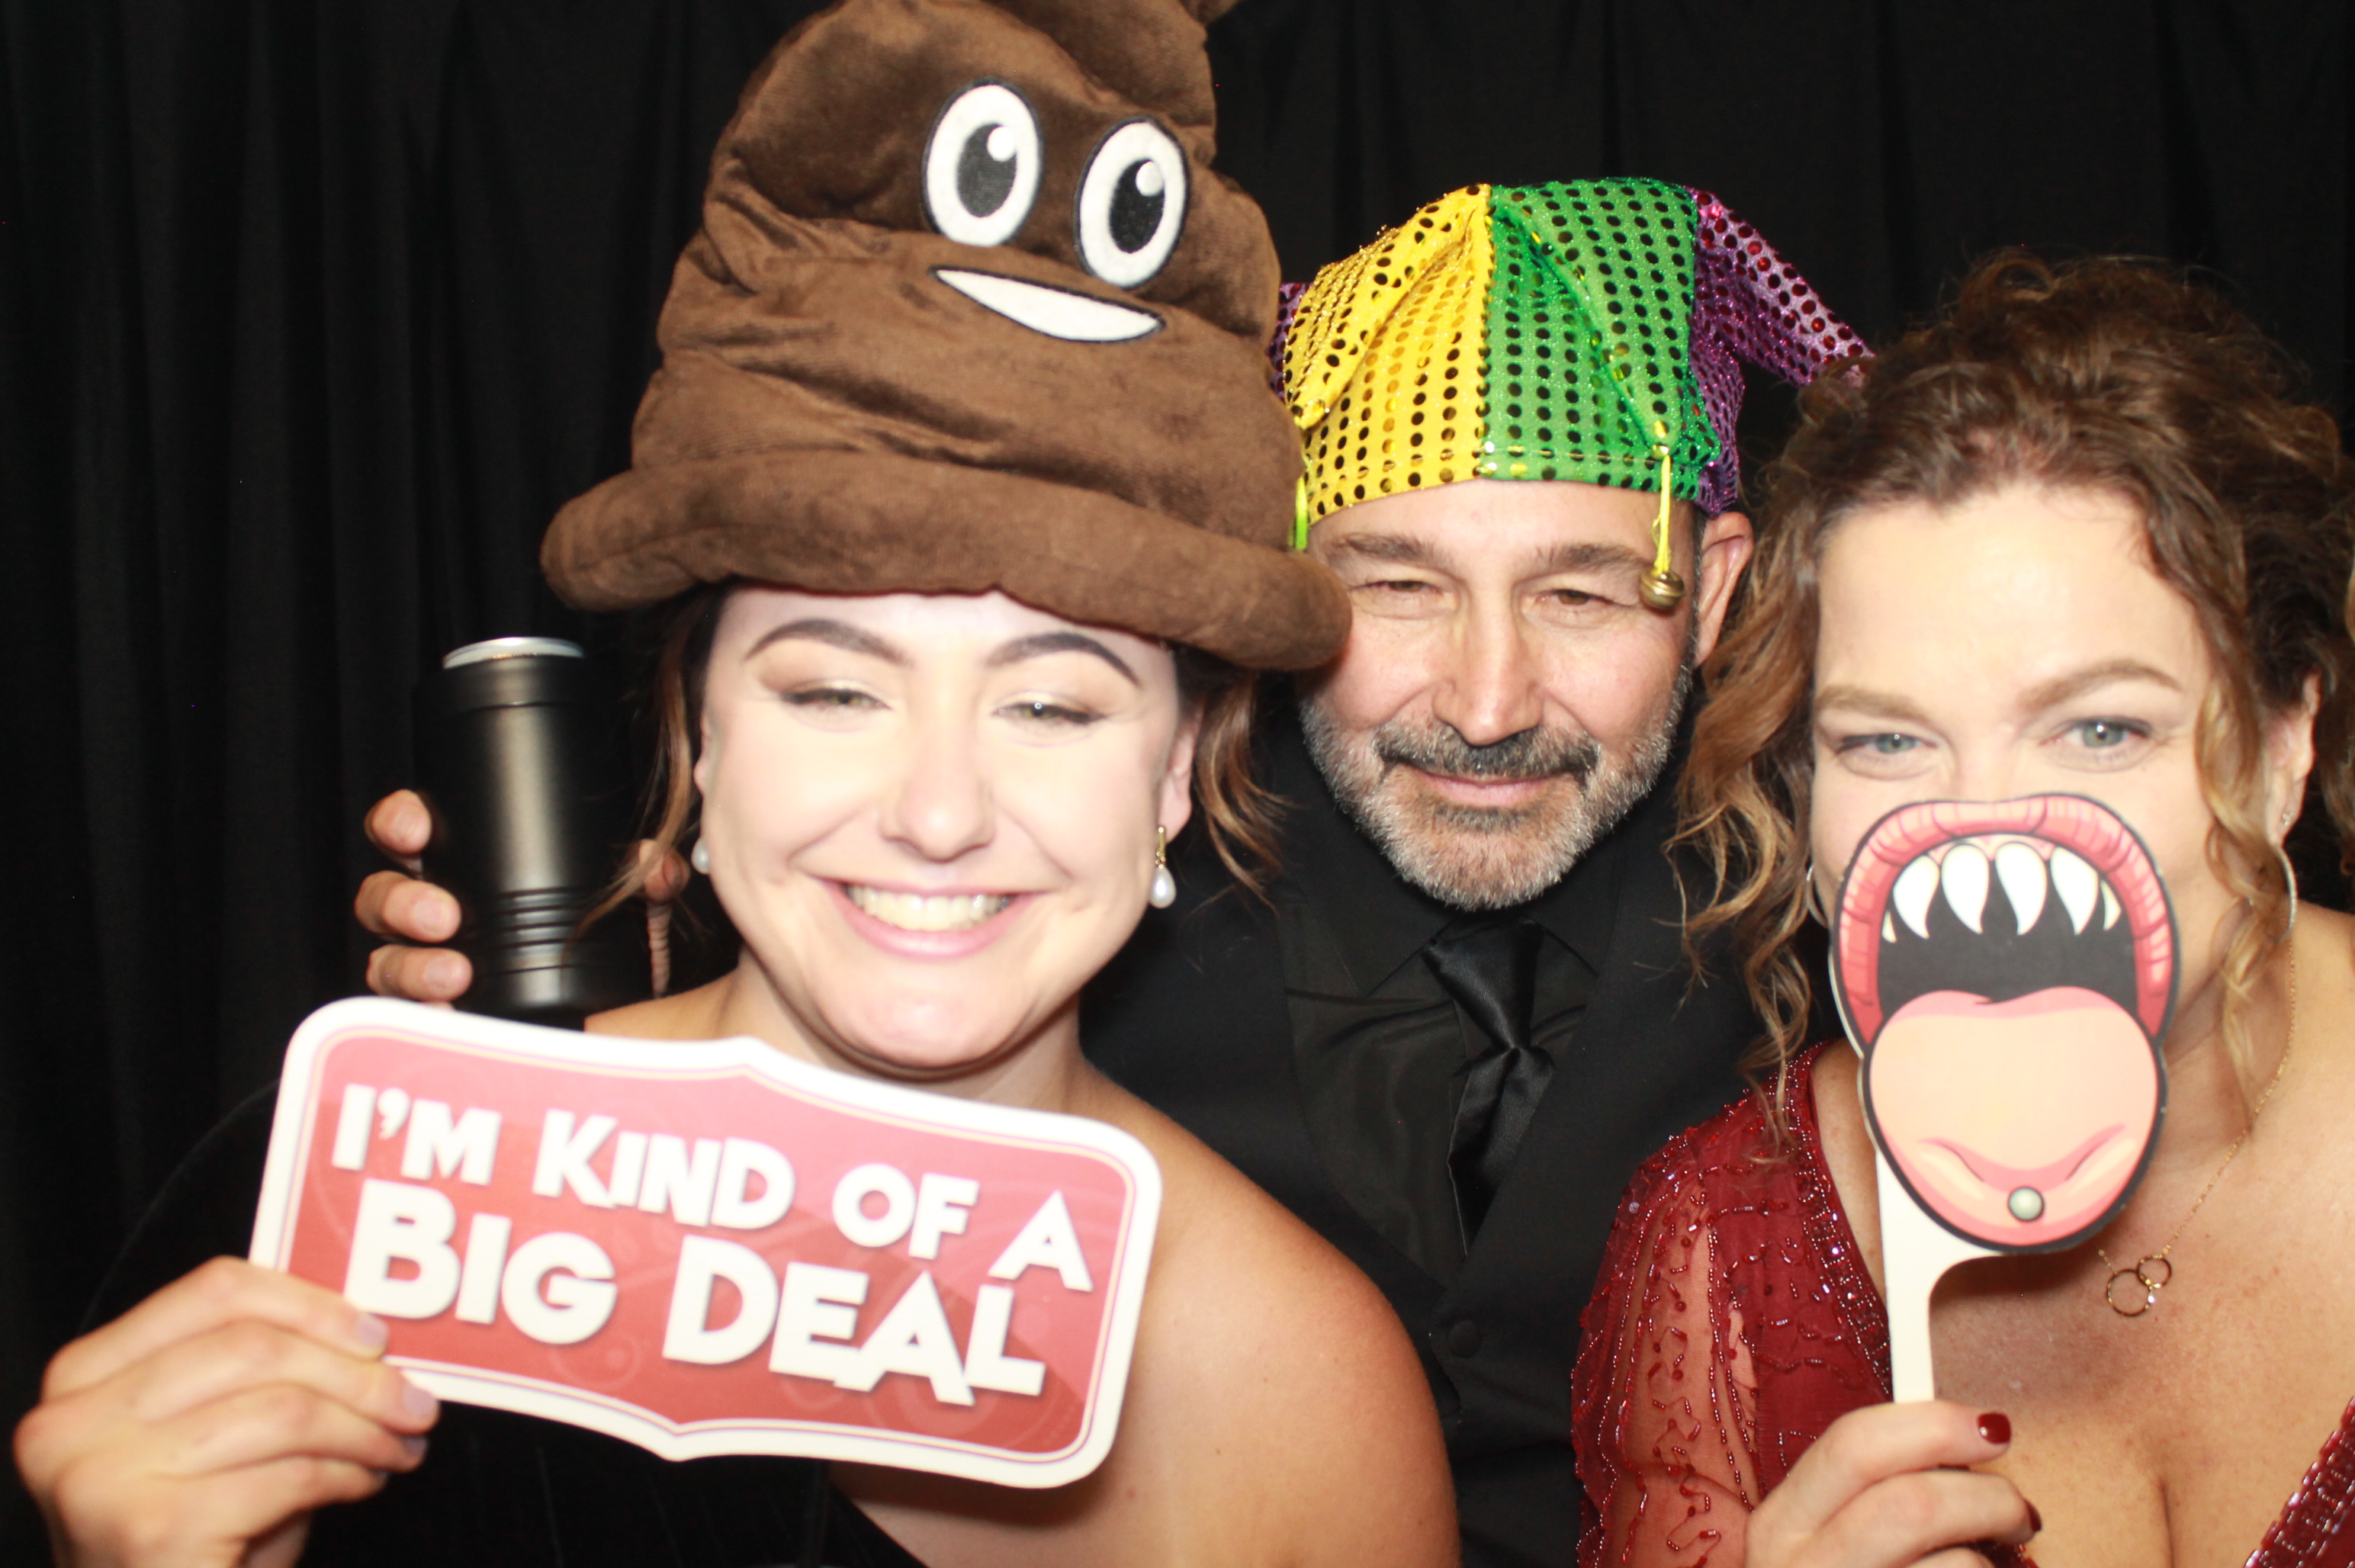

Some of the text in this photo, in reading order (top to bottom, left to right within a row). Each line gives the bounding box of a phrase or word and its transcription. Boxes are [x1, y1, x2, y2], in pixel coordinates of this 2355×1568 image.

[343, 1178, 1046, 1406] BIG DEAL
[532, 1110, 795, 1229] KIND
[831, 1163, 980, 1260] OF
[988, 1189, 1094, 1292] A
